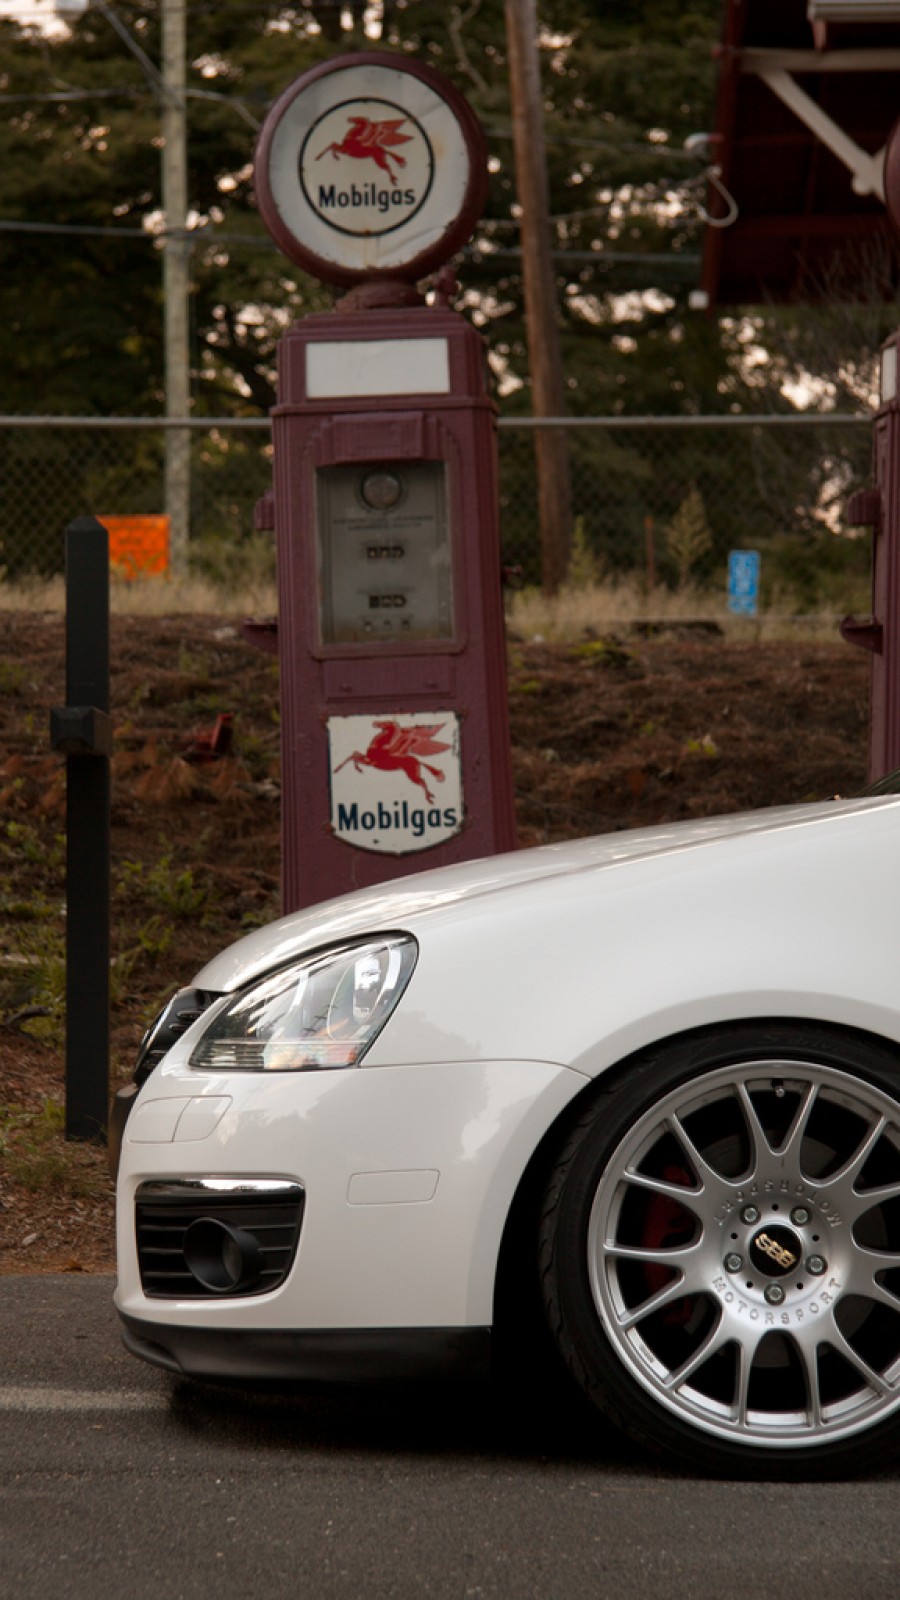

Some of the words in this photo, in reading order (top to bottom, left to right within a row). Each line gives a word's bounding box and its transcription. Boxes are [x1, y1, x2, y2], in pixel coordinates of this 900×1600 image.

[318, 183, 415, 212] Mobilgas
[337, 801, 457, 836] Mobilgas
[712, 1276, 842, 1324] MOTORSPORT
